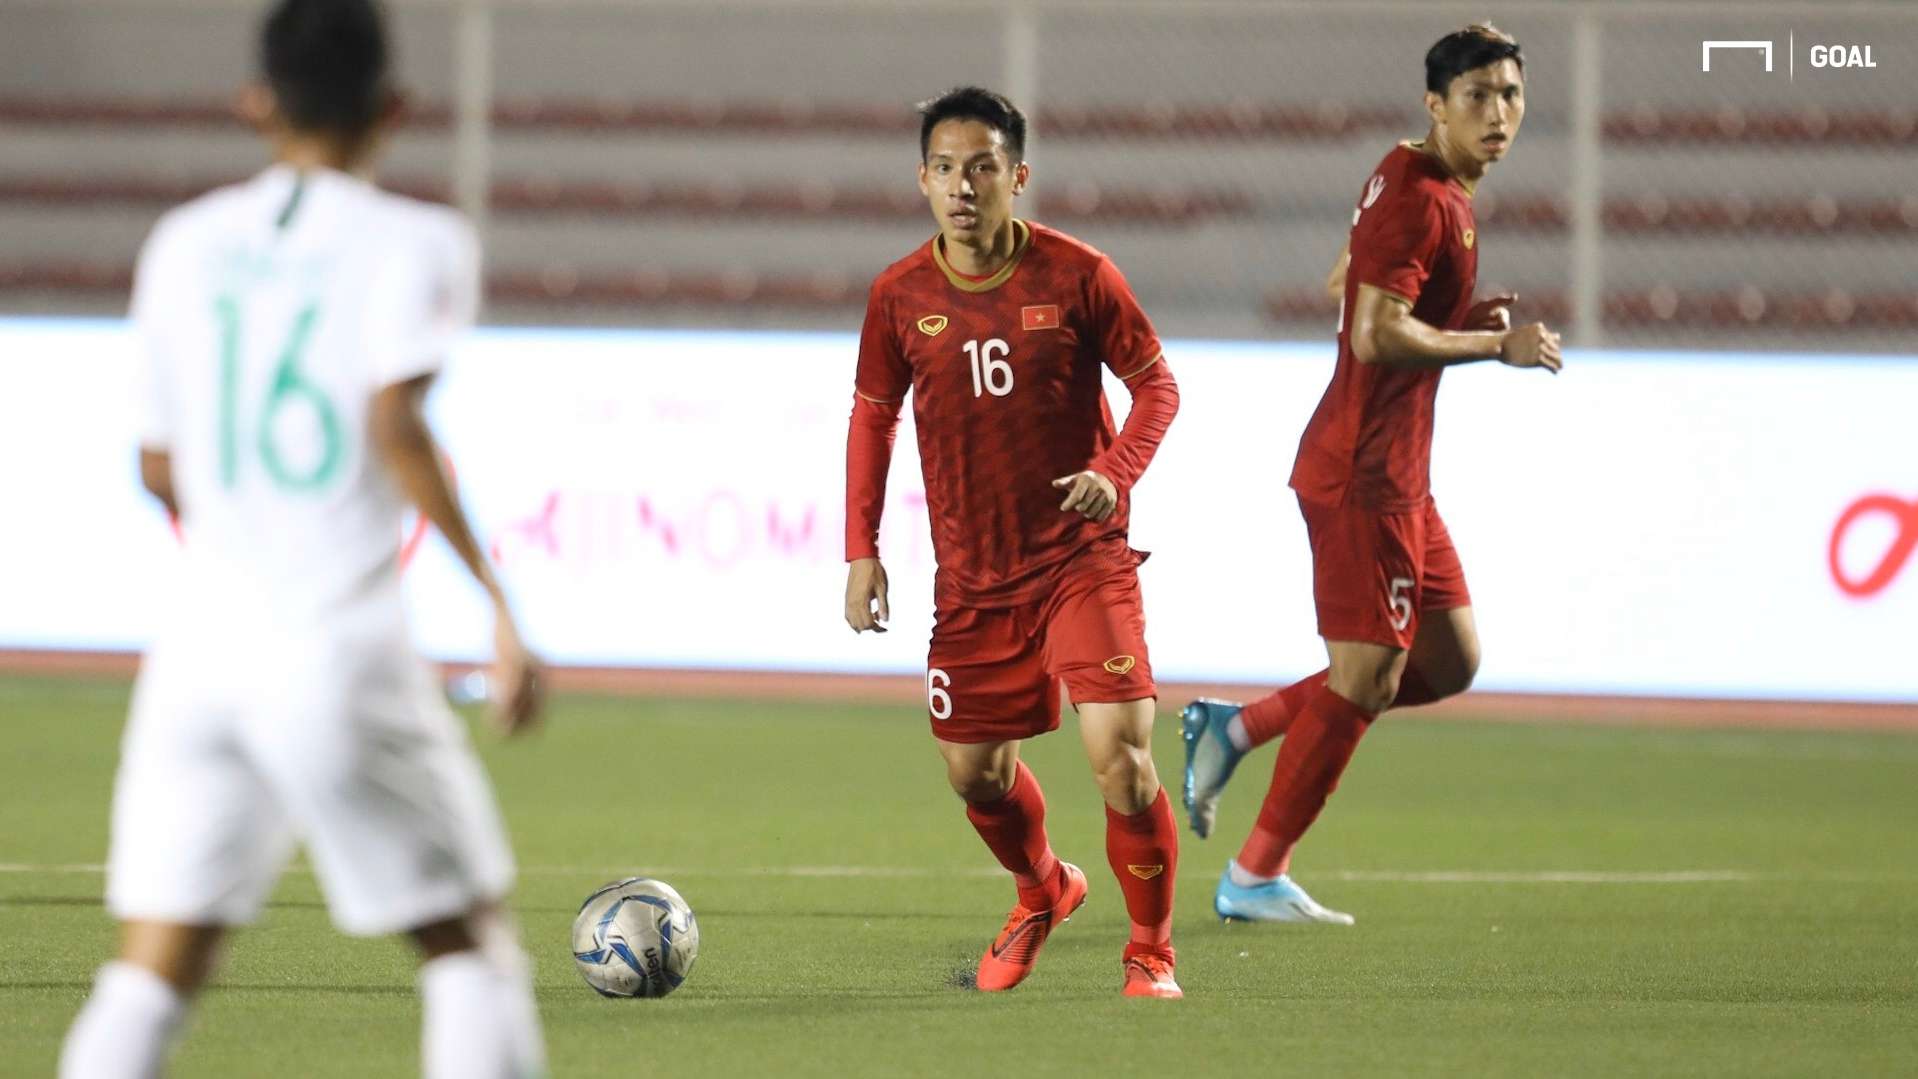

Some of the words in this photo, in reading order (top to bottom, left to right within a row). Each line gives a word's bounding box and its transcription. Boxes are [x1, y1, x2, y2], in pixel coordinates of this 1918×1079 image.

[212, 296, 343, 493] 16
[962, 338, 1014, 398] 16
[1389, 577, 1416, 632] 5
